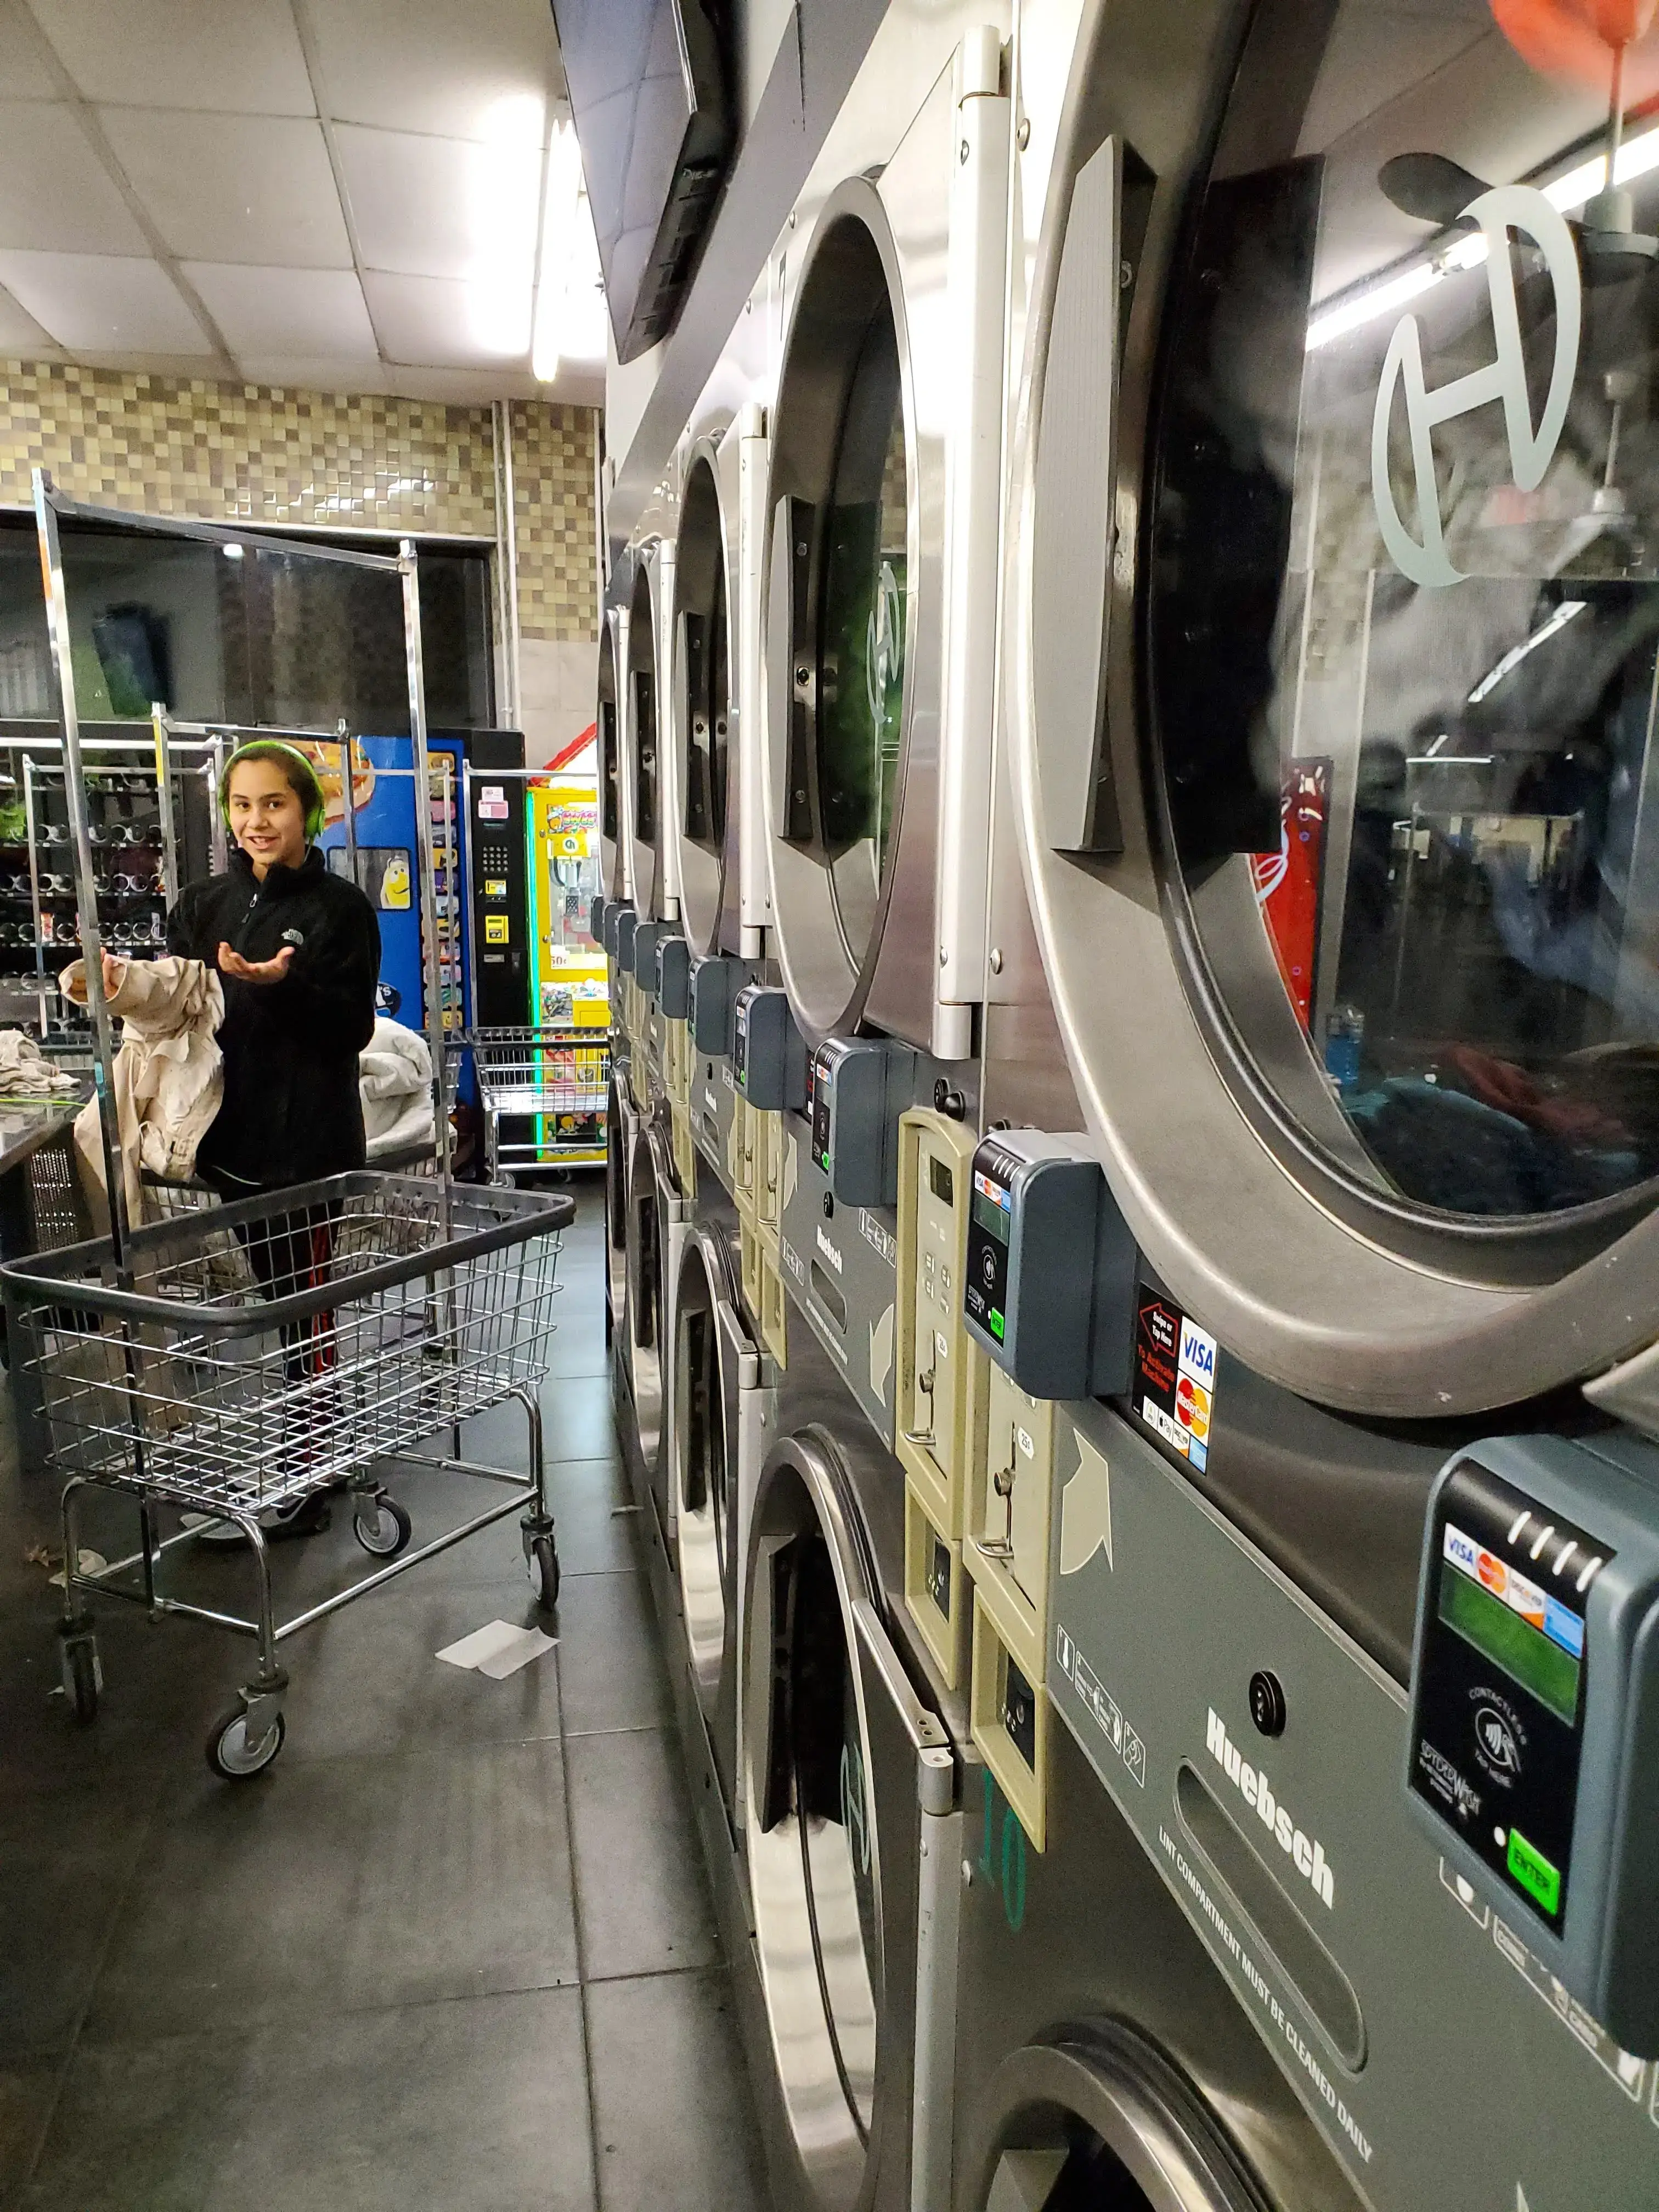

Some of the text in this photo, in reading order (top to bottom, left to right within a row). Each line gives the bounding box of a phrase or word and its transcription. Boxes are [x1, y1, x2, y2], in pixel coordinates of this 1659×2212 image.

[1152, 1324, 1172, 1347] Tap Here
[1153, 1311, 1172, 1332] Swipe or
[1184, 1331, 1212, 1376] VISA
[1177, 1390, 1207, 1422] MasterCard
[1164, 1419, 1172, 1437] Pay
[1174, 1428, 1188, 1444] DISCVER
[1449, 1536, 1474, 1566] VISA
[1207, 1707, 1334, 1910] Huebsch
[1159, 1825, 1373, 2163] LINT COMPARTMENT MUST BE CLEANED DAILY
